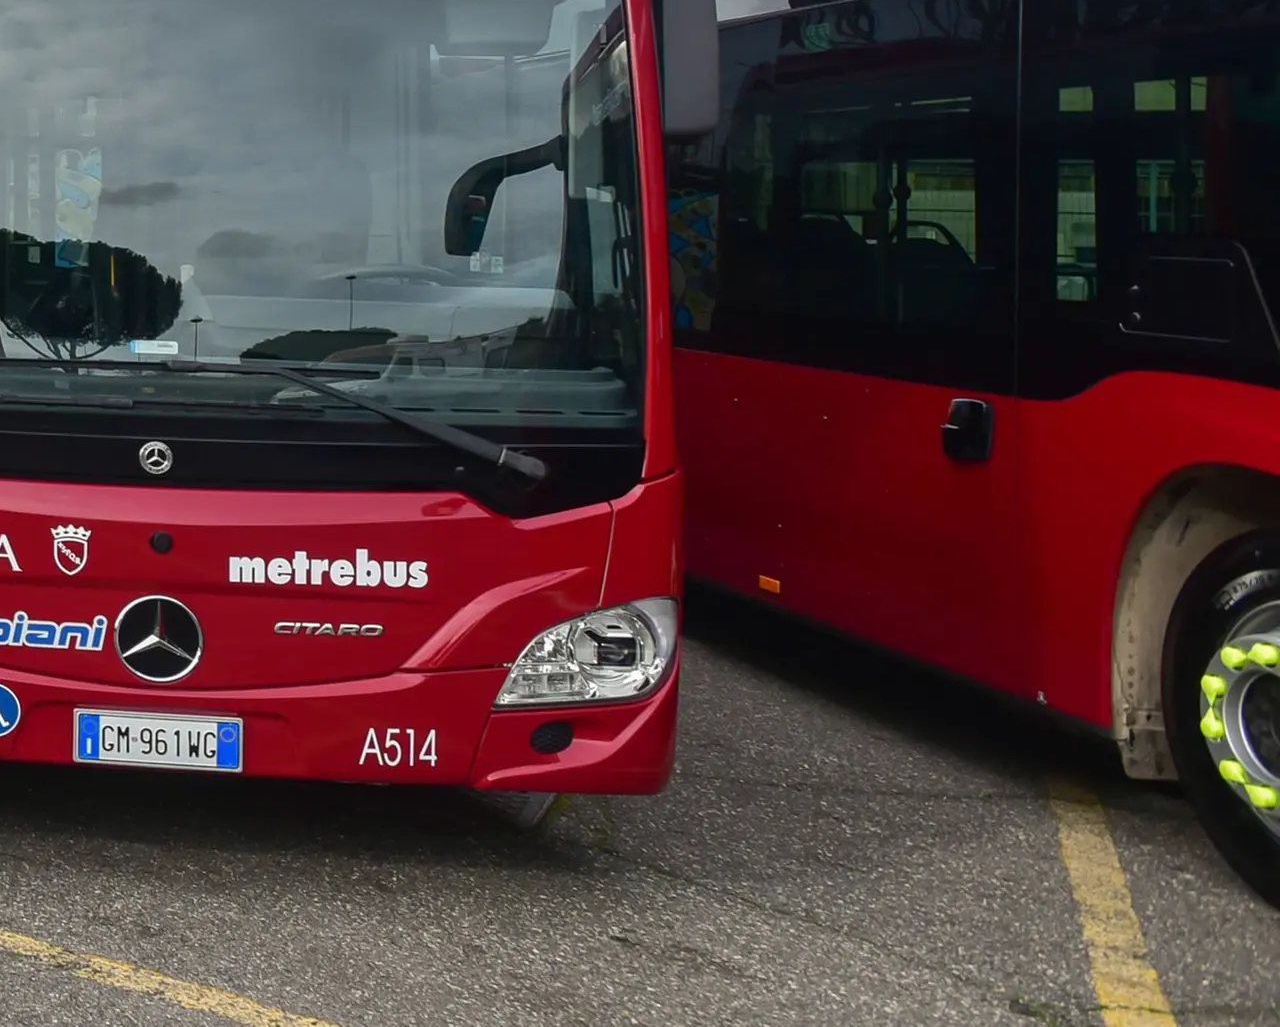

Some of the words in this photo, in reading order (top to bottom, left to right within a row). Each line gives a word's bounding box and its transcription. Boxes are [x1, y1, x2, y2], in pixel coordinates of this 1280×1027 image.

[229, 548, 429, 588] metrebus
[274, 621, 384, 636] CITARO
[358, 727, 438, 767] A514
